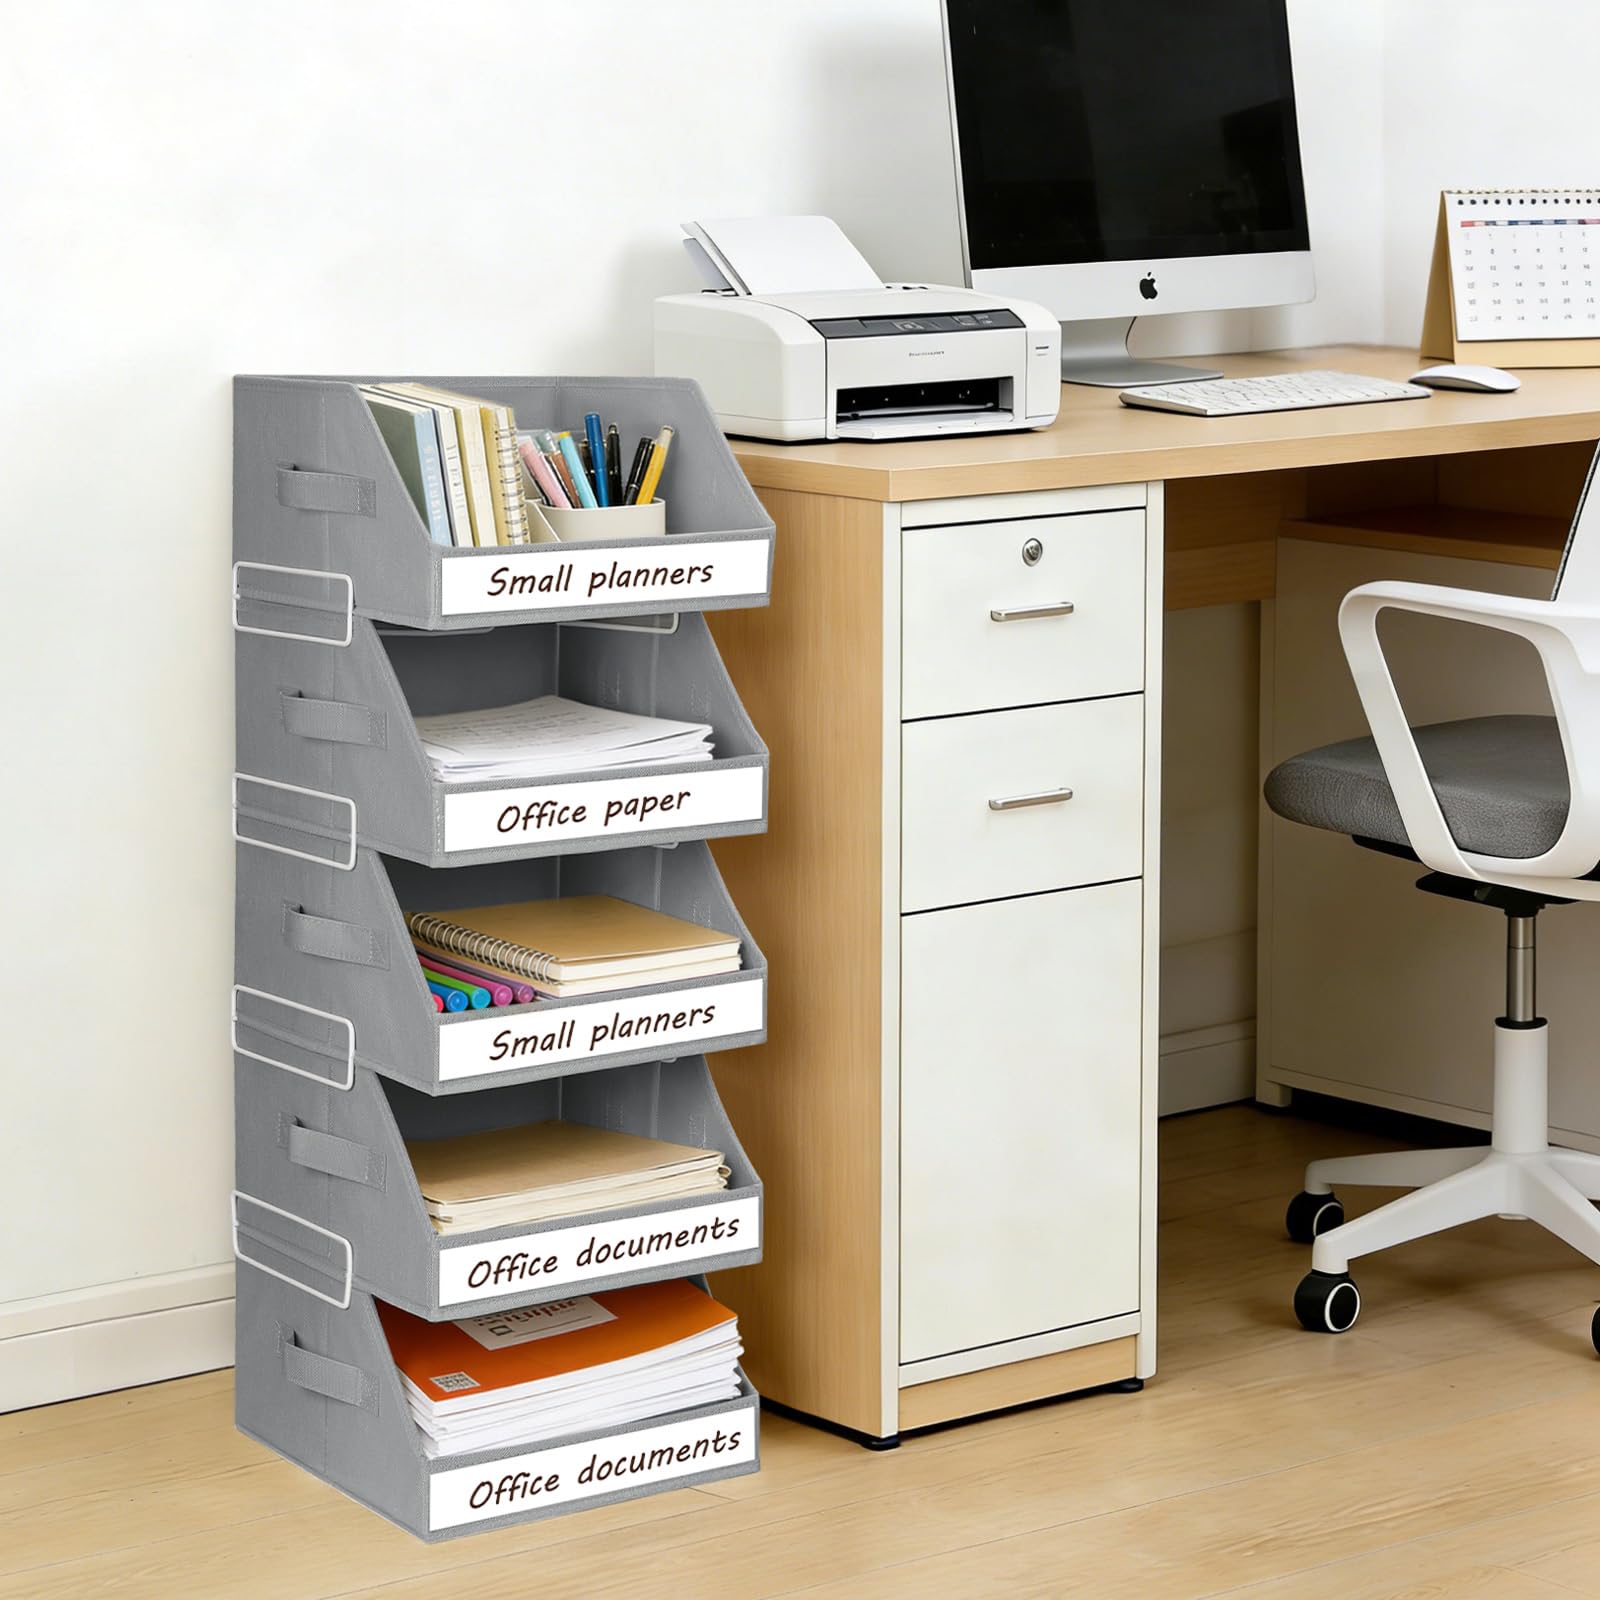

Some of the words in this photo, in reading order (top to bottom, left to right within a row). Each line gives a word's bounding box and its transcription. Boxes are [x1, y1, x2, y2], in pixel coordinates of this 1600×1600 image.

[487, 564, 573, 596] Small
[587, 561, 714, 597] planners
[497, 800, 587, 833] Office
[603, 791, 691, 827] paper
[489, 1019, 576, 1061] Small
[589, 1005, 716, 1052] planners
[468, 1252, 558, 1288] Office
[576, 1217, 740, 1267] documents
[469, 1472, 560, 1509] Office
[577, 1430, 741, 1484] documents
